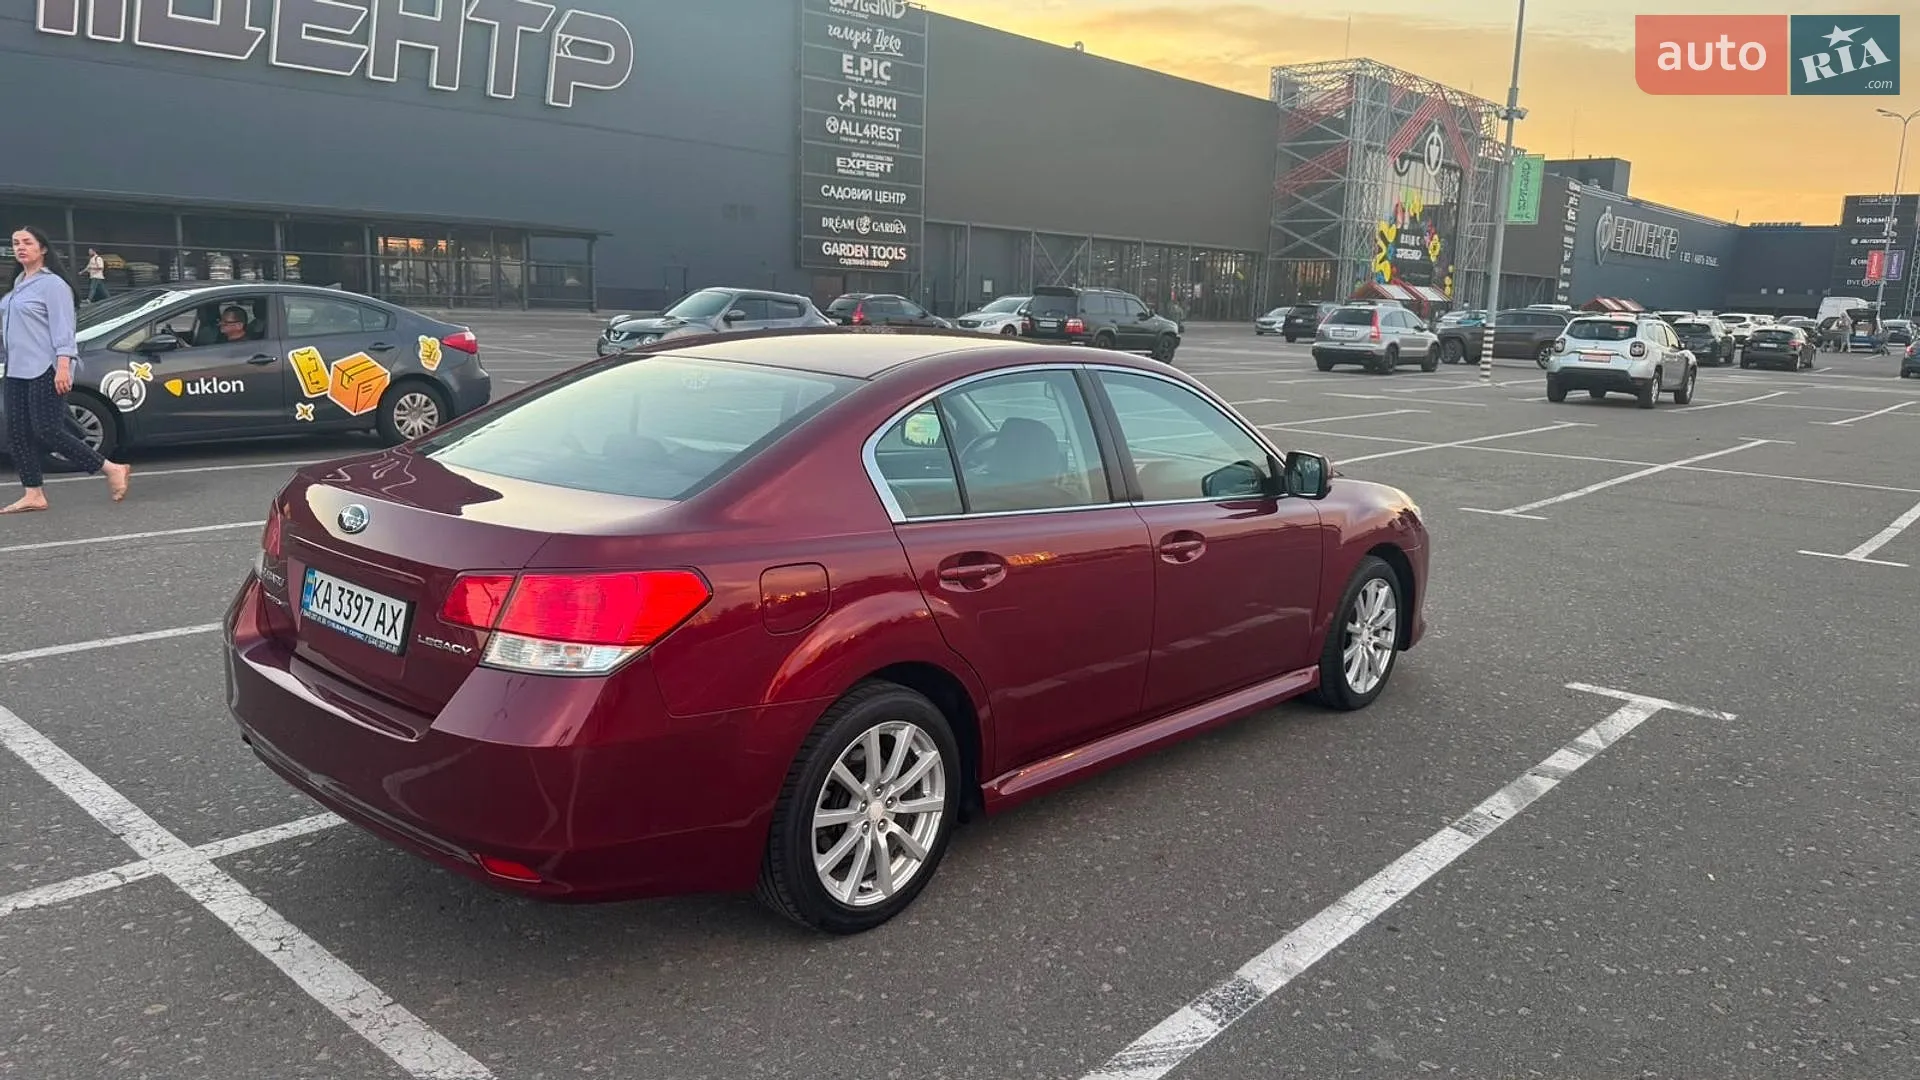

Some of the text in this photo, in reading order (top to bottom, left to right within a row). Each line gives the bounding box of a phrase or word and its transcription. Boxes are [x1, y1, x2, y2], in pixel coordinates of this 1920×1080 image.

[842, 53, 892, 81] E.PIC
[839, 118, 902, 142] ALL4REST
[836, 157, 894, 173] EXPERT
[821, 184, 907, 205] САДОВИЙ ЦЕНТР
[821, 214, 906, 234] DREAM GARDEN
[822, 241, 907, 261] GARDEN TOOLS
[186, 377, 245, 396] uklon
[310, 577, 332, 613] KA
[334, 586, 374, 627] 3397
[374, 602, 403, 641] AX
[417, 633, 472, 656] LEGACY
